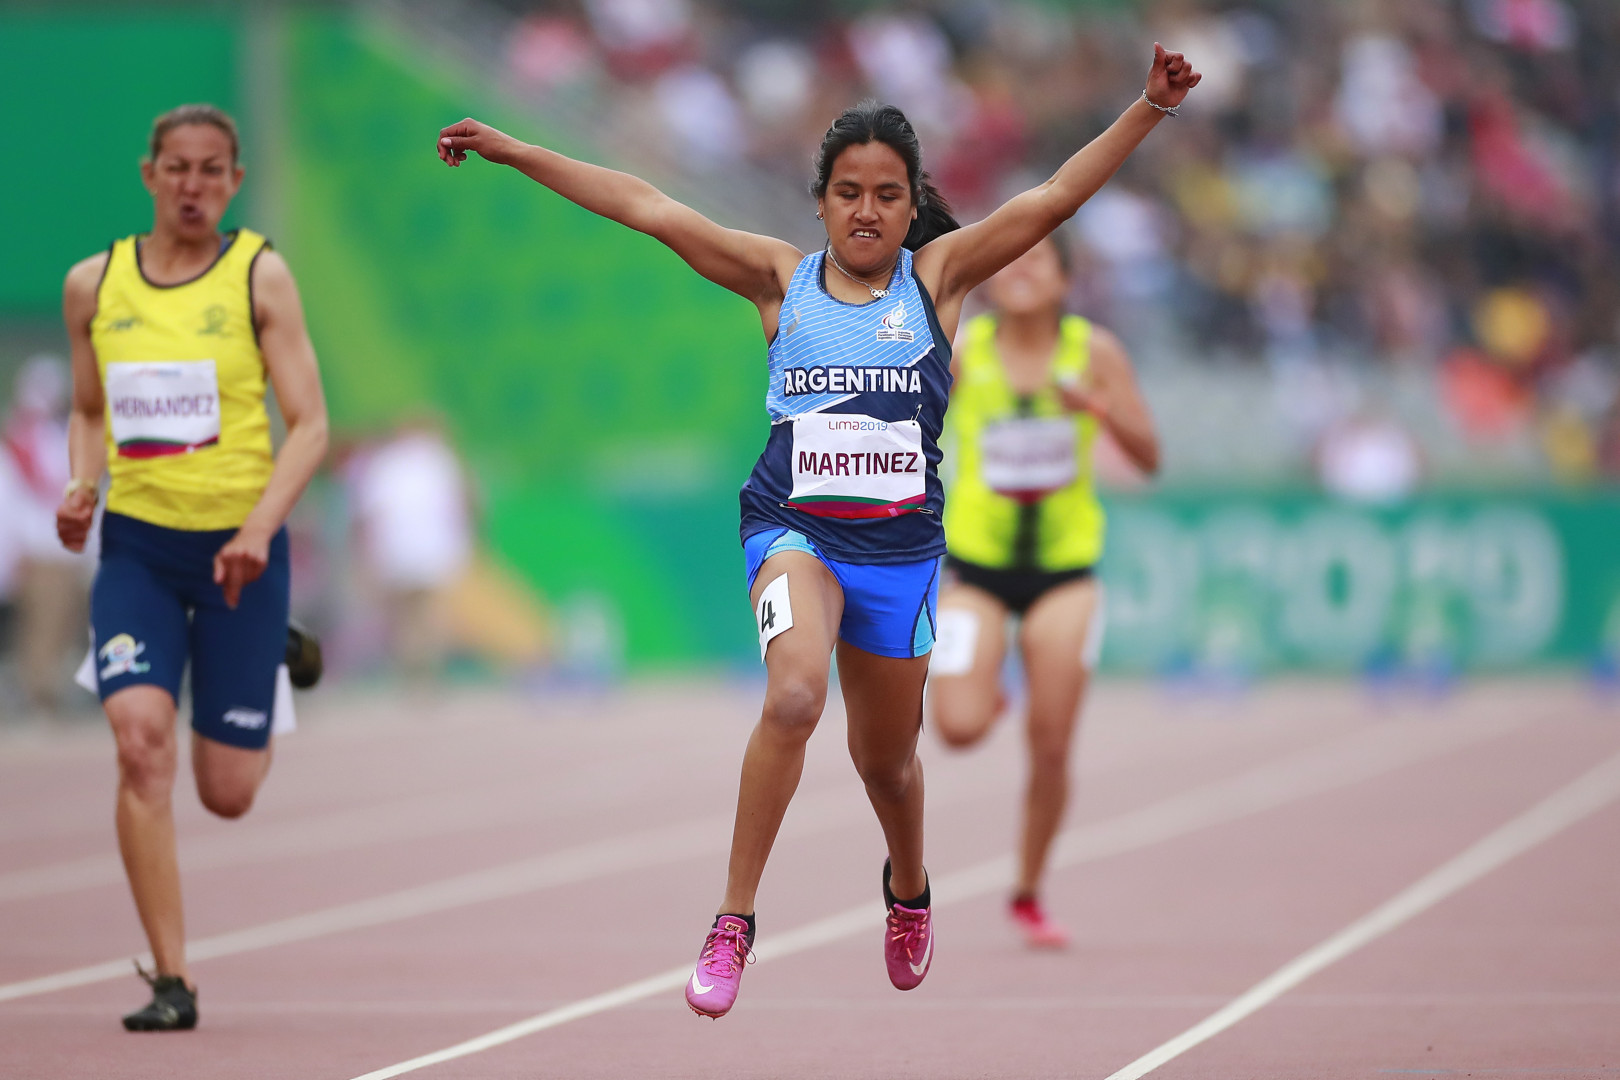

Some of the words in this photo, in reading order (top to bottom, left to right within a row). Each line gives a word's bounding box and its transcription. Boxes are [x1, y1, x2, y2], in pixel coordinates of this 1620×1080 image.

[784, 367, 922, 395] ARGENTINA
[113, 394, 214, 418] HERNANDEZ
[798, 450, 919, 477] MARTINEZ
[761, 599, 777, 634] 4
